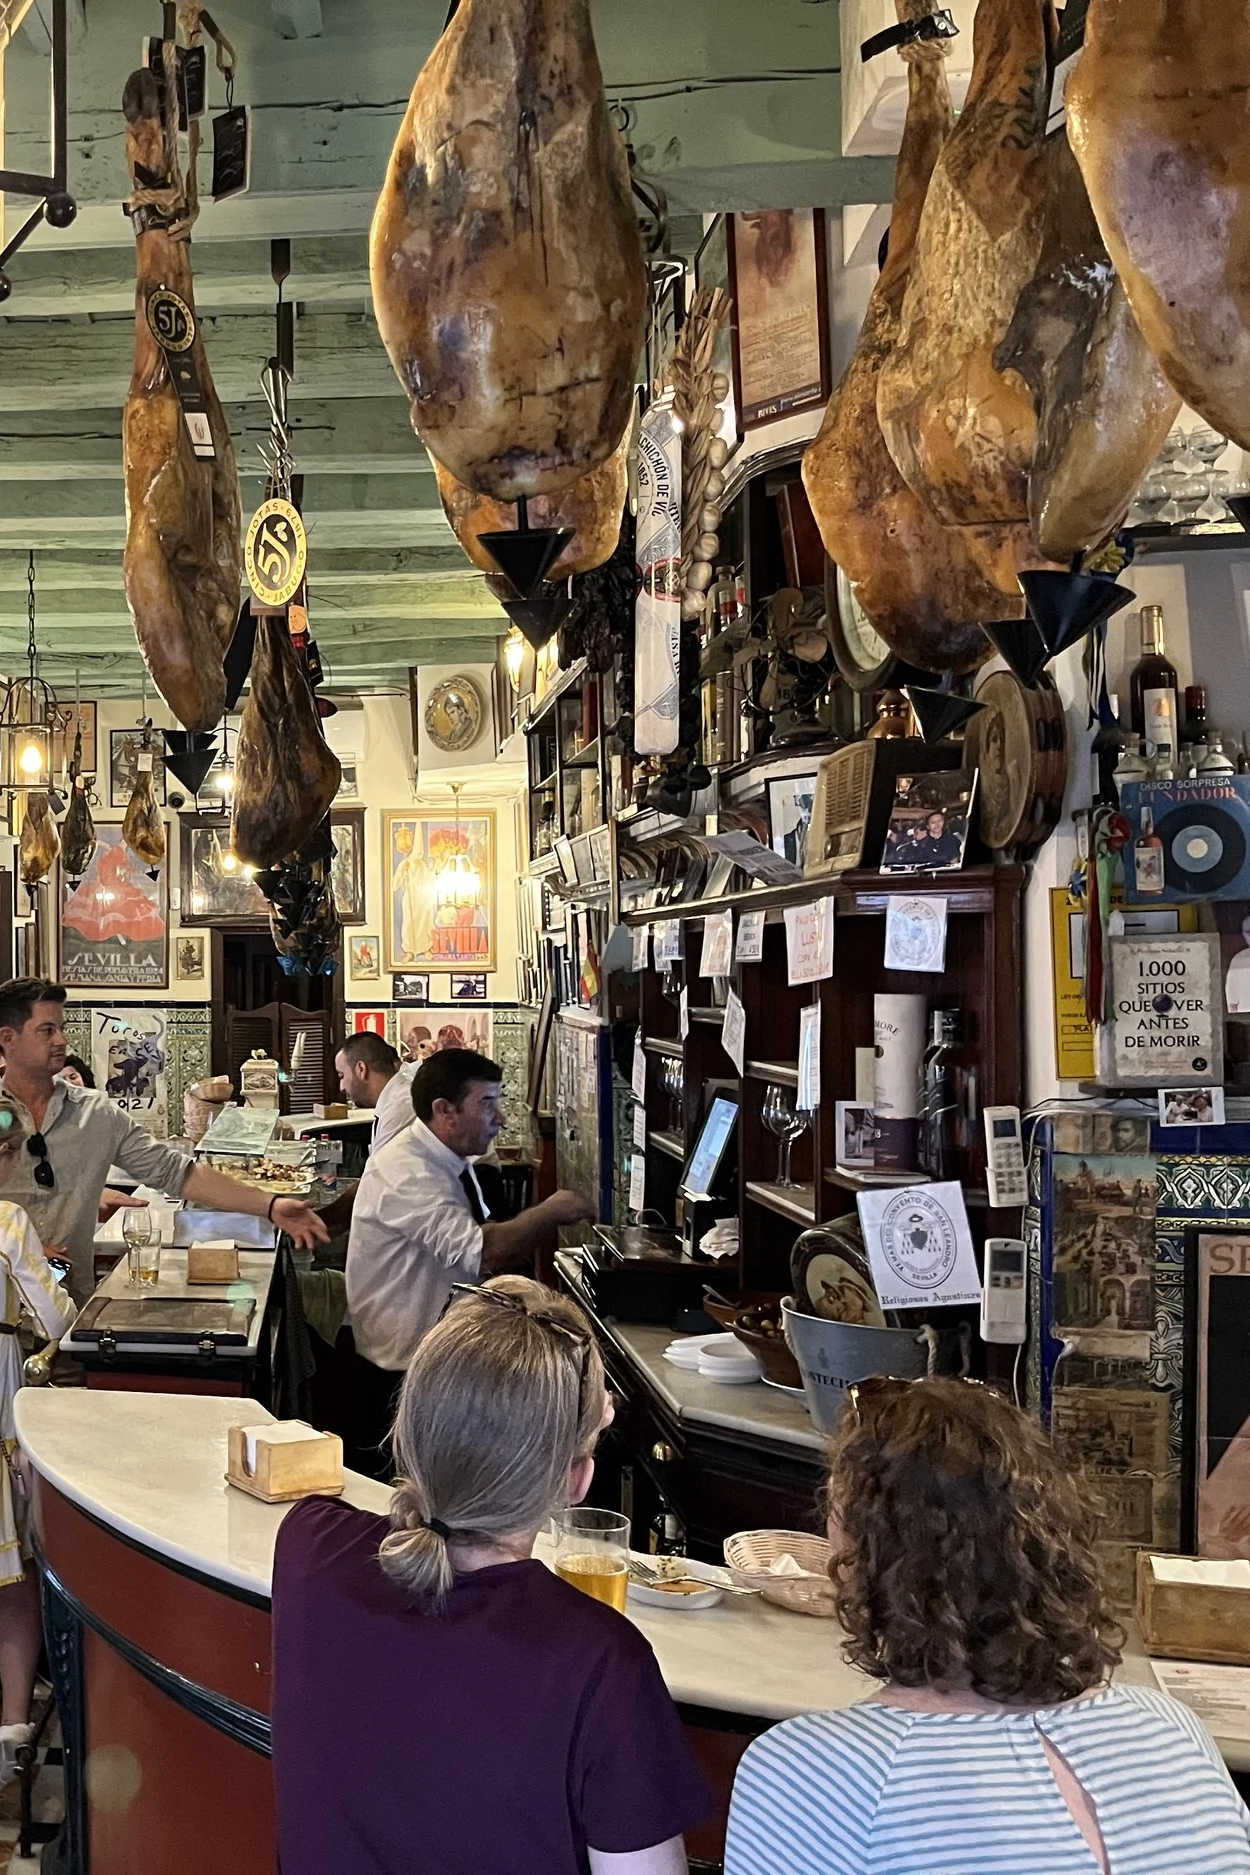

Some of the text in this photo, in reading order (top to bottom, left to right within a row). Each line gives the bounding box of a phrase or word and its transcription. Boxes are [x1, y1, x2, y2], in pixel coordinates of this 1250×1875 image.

[656, 484, 669, 499] DE
[250, 502, 279, 536] JOTAS
[273, 550, 305, 602] JABUGO
[1140, 777, 1231, 792] DISCO SORPRESA
[1138, 786, 1238, 804] FUNDADOR
[431, 927, 489, 954] SEVILLA
[67, 953, 158, 967] SEVILLA
[1139, 960, 1186, 977] 1.000
[1137, 982, 1185, 995] SITIOS
[1119, 1000, 1205, 1013] QUE VER
[1137, 1017, 1189, 1030] ANTES
[1124, 1035, 1201, 1048] DE MORIR
[888, 1196, 922, 1226] CONVENTO
[923, 1200, 934, 1210] DE
[912, 1271, 938, 1281] SEVILLA
